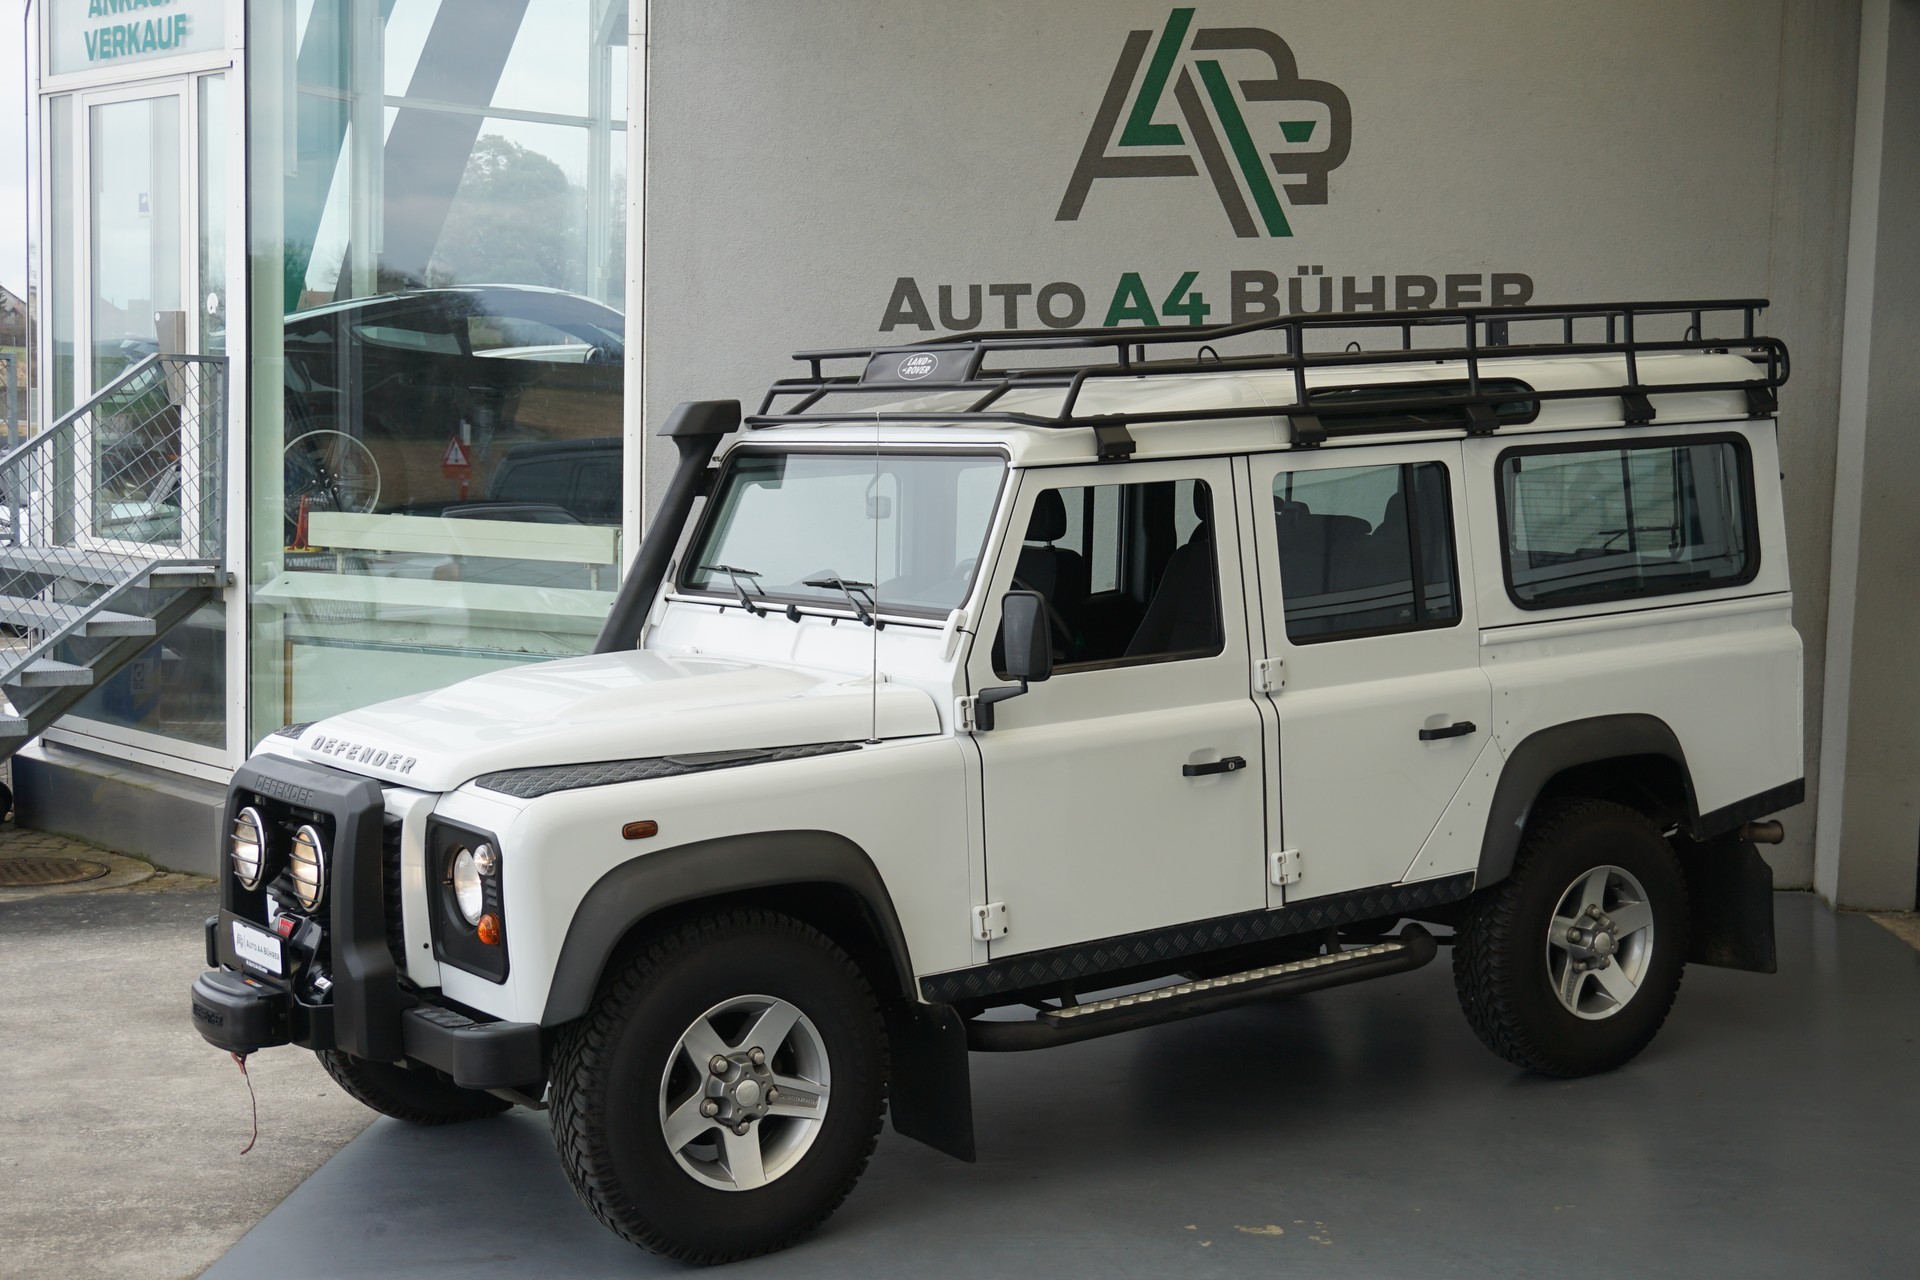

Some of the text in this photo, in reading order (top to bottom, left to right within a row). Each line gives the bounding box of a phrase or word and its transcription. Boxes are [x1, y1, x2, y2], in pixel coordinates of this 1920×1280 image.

[84, 13, 187, 61] VERKAUF
[878, 277, 1086, 332] AUTO
[1103, 272, 1210, 327] A4
[904, 366, 931, 375] ROVER
[907, 357, 929, 366] LAND
[310, 735, 417, 774] DEFENDER
[254, 774, 314, 806] DEFENDER
